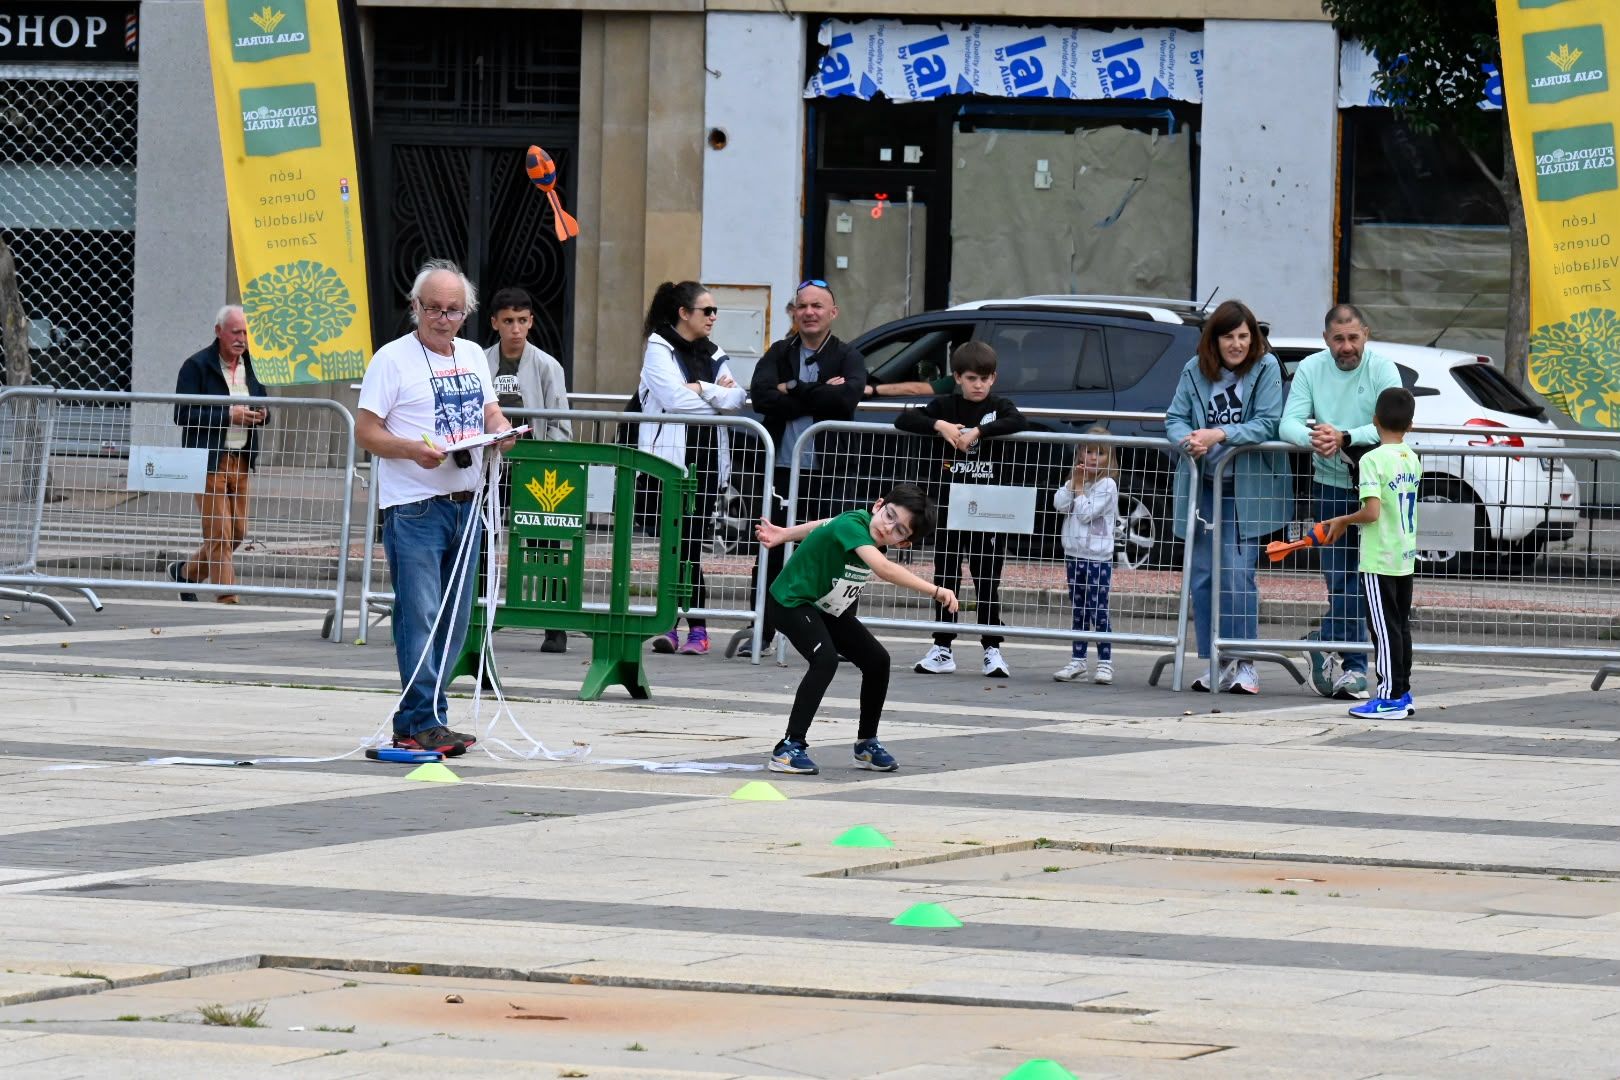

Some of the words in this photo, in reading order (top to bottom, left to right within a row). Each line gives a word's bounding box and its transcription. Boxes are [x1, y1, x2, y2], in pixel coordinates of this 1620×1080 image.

[876, 24, 885, 38] Top
[1168, 29, 1177, 43] Top
[867, 34, 877, 74] Worldwide
[876, 39, 886, 69] Quality
[898, 46, 909, 61] by
[963, 36, 974, 76] Worldwide
[972, 41, 982, 71] Quality
[994, 48, 1005, 63] by
[1061, 37, 1070, 78] Worldwide
[1070, 41, 1081, 71] Quality
[1091, 49, 1102, 64] by
[1159, 39, 1167, 79] Worldwide
[1168, 44, 1178, 73] Quality
[1190, 51, 1200, 66] by
[876, 69, 884, 85] ACM
[972, 71, 981, 87] ACM
[1069, 71, 1077, 89] ACM
[1167, 73, 1175, 91] ACM
[431, 373, 481, 394] PALMS
[499, 384, 511, 392] THE
[514, 514, 541, 526] CAJA
[543, 515, 583, 528] RURAL
